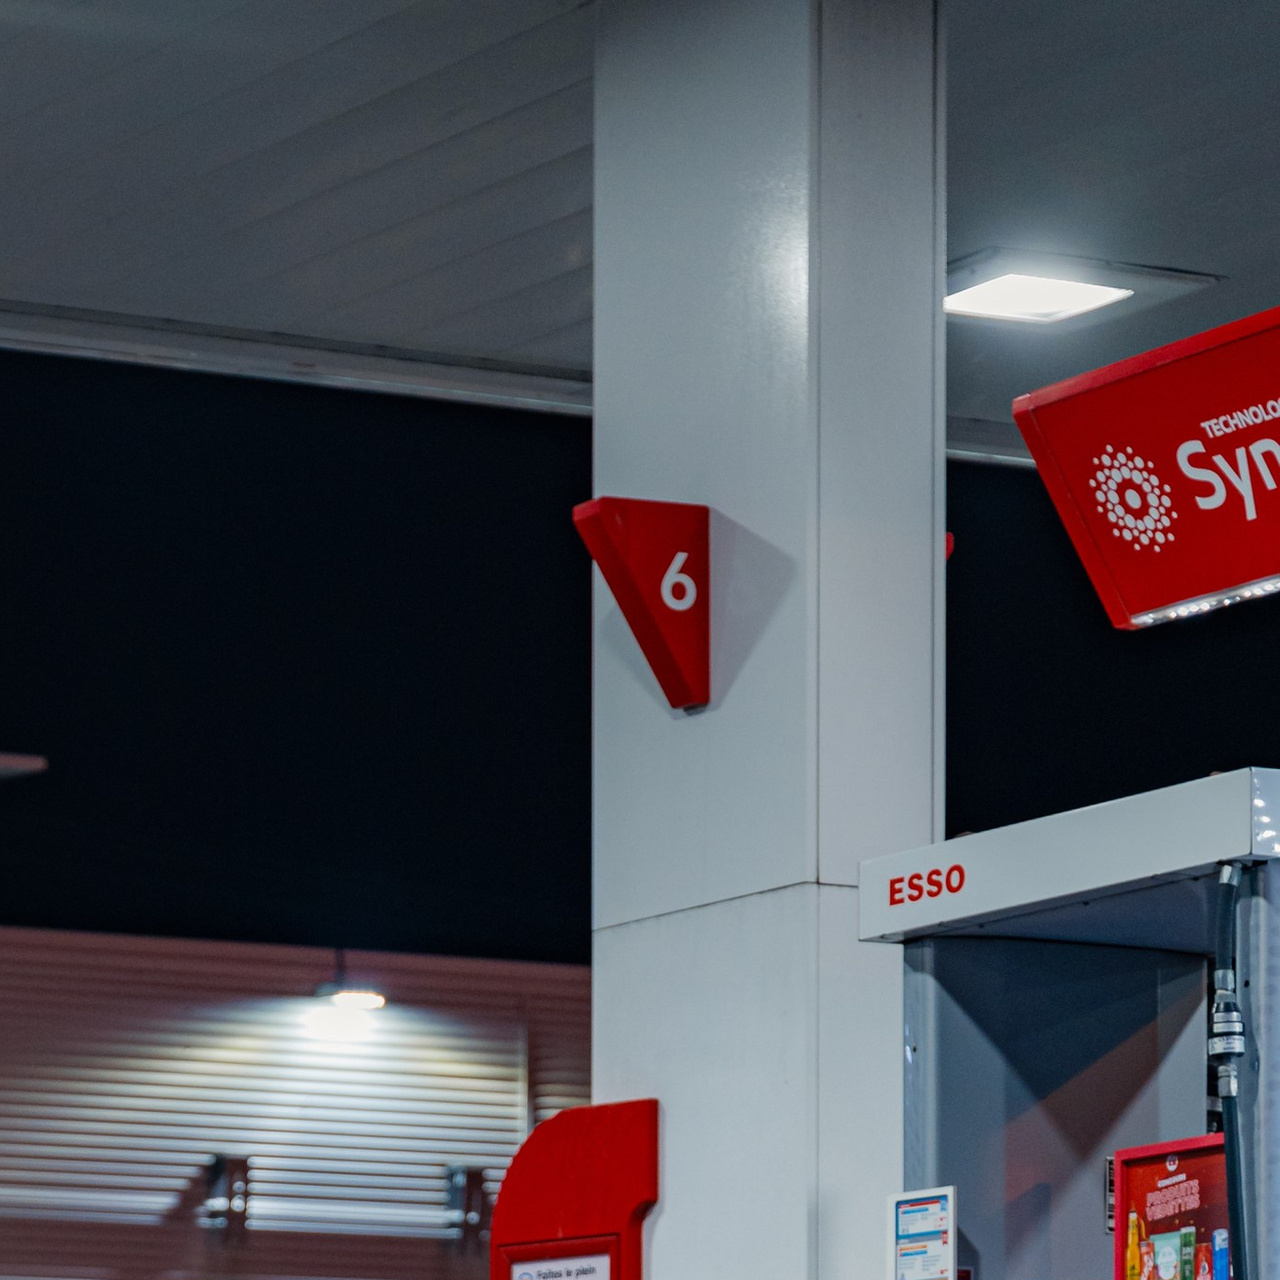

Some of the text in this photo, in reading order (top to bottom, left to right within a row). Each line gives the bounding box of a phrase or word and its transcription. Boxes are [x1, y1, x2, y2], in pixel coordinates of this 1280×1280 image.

[1200, 398, 1280, 439] TECHNOLO
[660, 551, 697, 611] 6
[888, 864, 965, 906] ESSO
